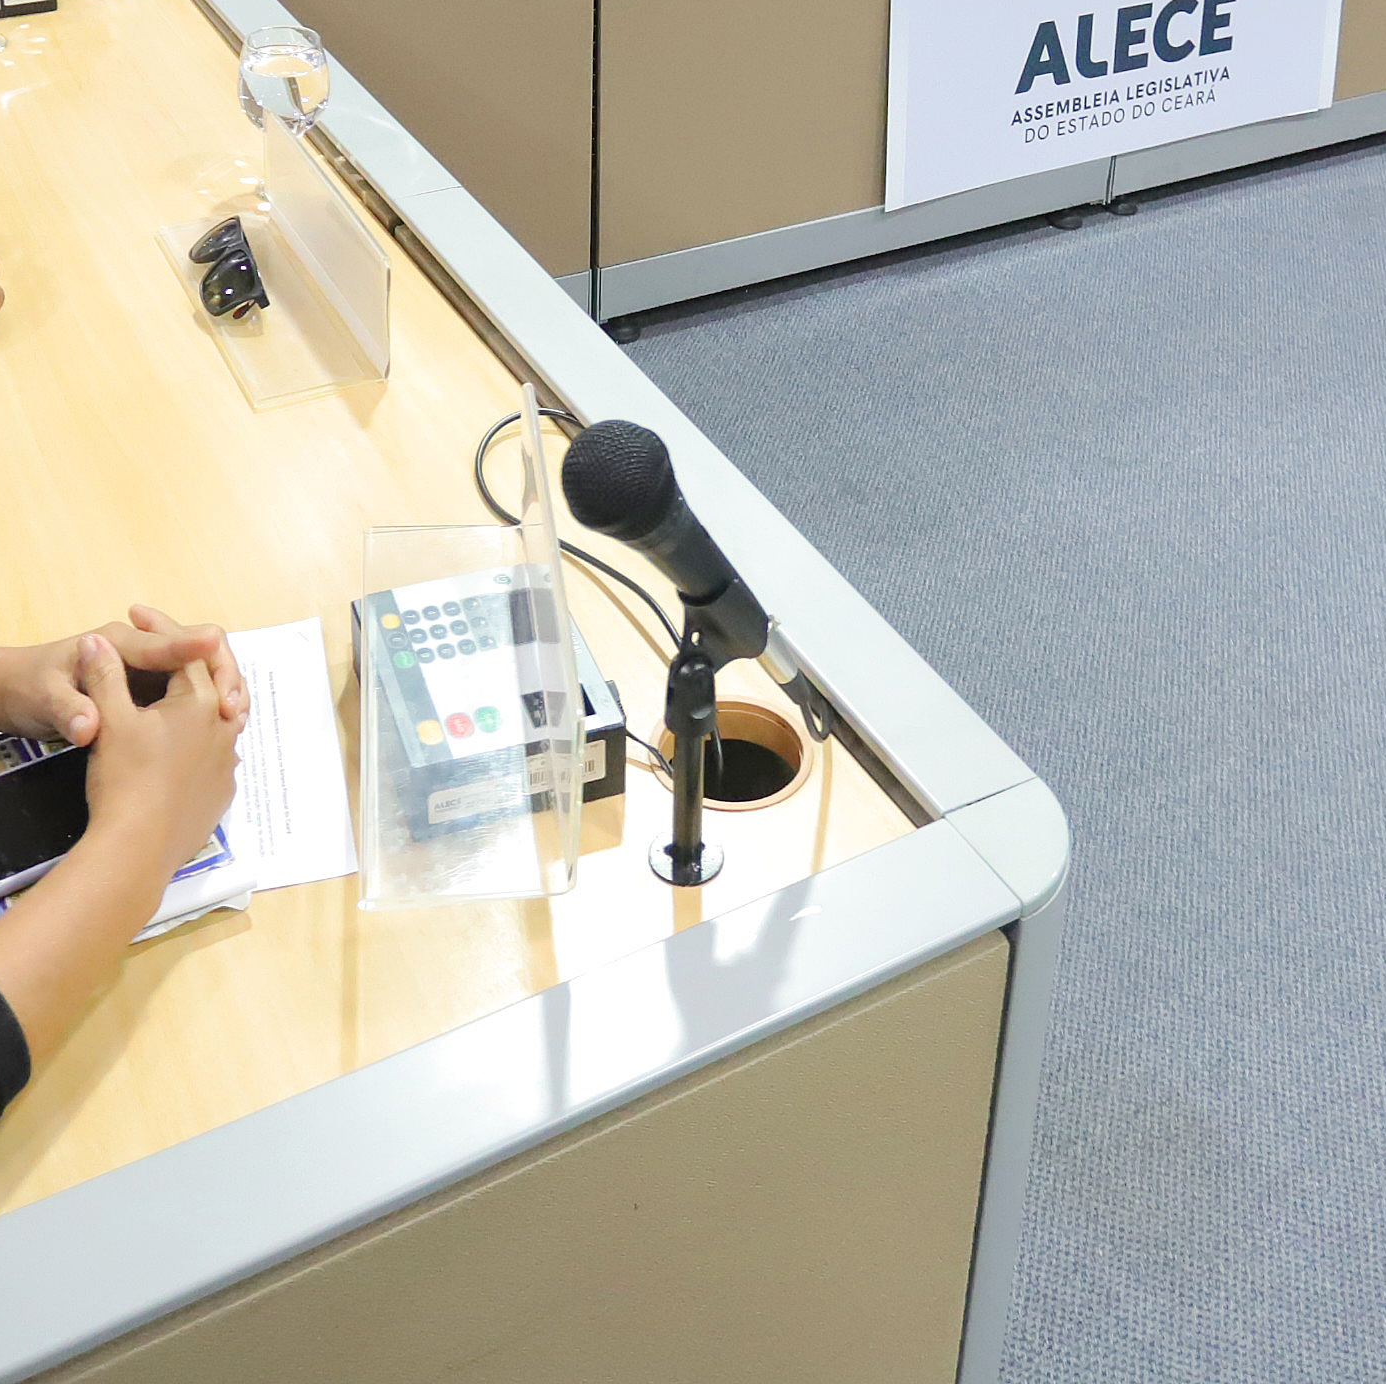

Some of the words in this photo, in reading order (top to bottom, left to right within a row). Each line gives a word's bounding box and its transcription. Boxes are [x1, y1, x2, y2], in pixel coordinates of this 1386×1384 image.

[1011, 89, 1120, 126] ASSEMBLEIA
[1126, 66, 1231, 101] LEGISLATIVA
[1024, 125, 1050, 143] DO
[1057, 108, 1126, 136] ESTADO
[1132, 101, 1156, 120] DO
[1162, 85, 1217, 113] CEARÁ
